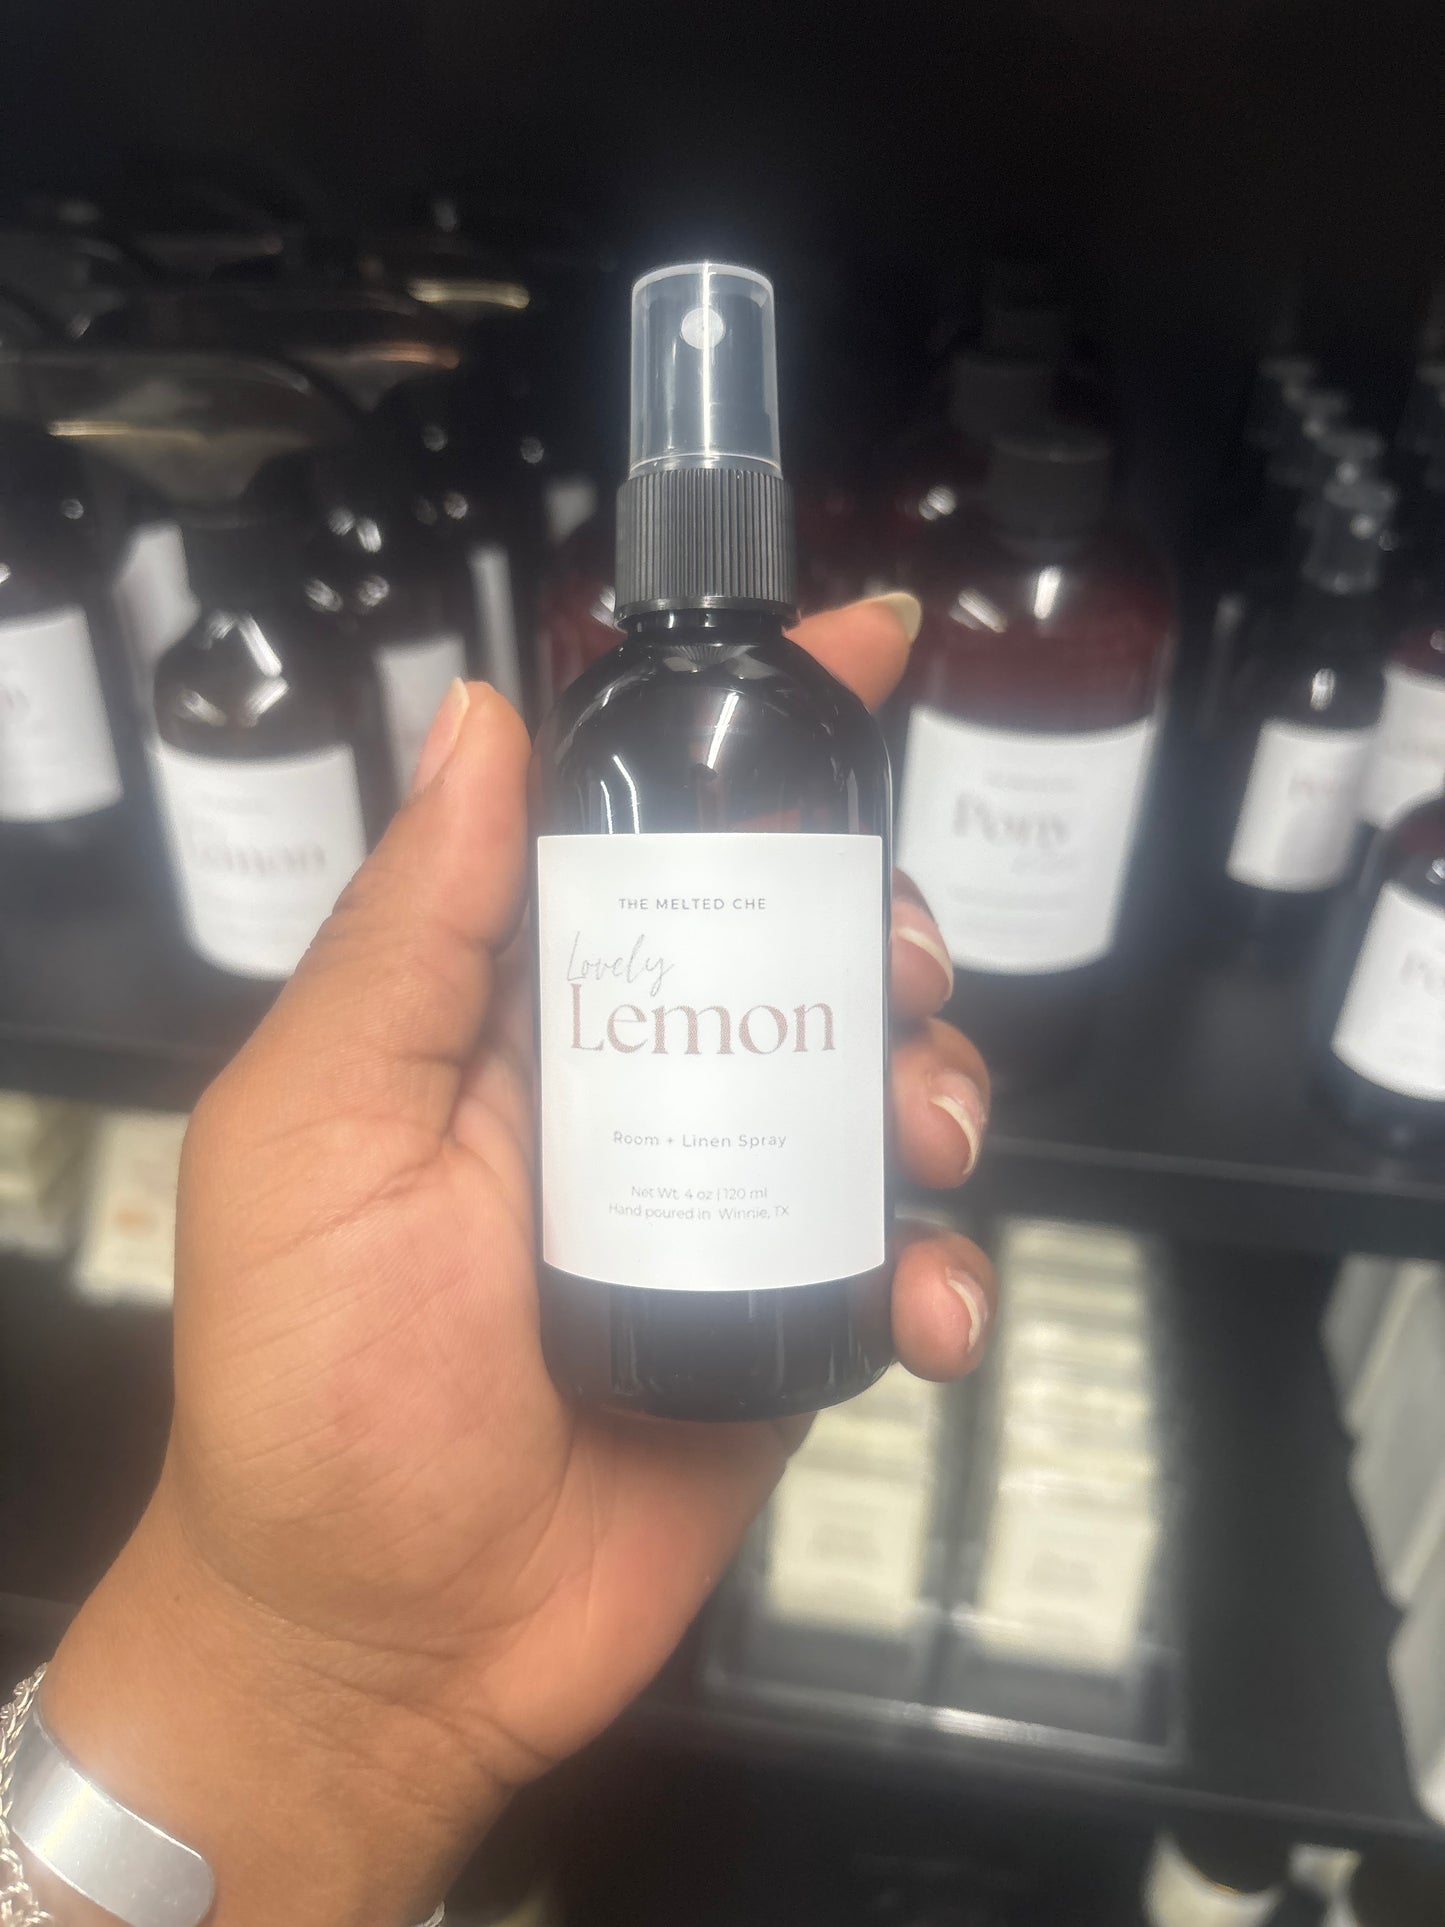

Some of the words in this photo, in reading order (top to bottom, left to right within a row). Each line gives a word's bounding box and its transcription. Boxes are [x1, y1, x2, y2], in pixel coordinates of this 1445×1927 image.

[619, 898, 649, 910] THE
[656, 898, 725, 910] MELTED
[732, 898, 767, 910] CHE
[567, 931, 674, 997] Lovely
[570, 983, 836, 1055] Lemon
[613, 1130, 659, 1146] Room
[682, 1134, 731, 1148] Linen
[738, 1134, 787, 1150] Spray
[631, 1186, 653, 1199] Net
[684, 1189, 693, 1200] 4
[697, 1190, 713, 1201] oz
[723, 1188, 746, 1200] 120
[749, 1187, 768, 1199] ml
[608, 1203, 641, 1217] Hand
[645, 1207, 694, 1220] poured
[698, 1208, 711, 1220] in
[775, 1205, 790, 1217] TX
